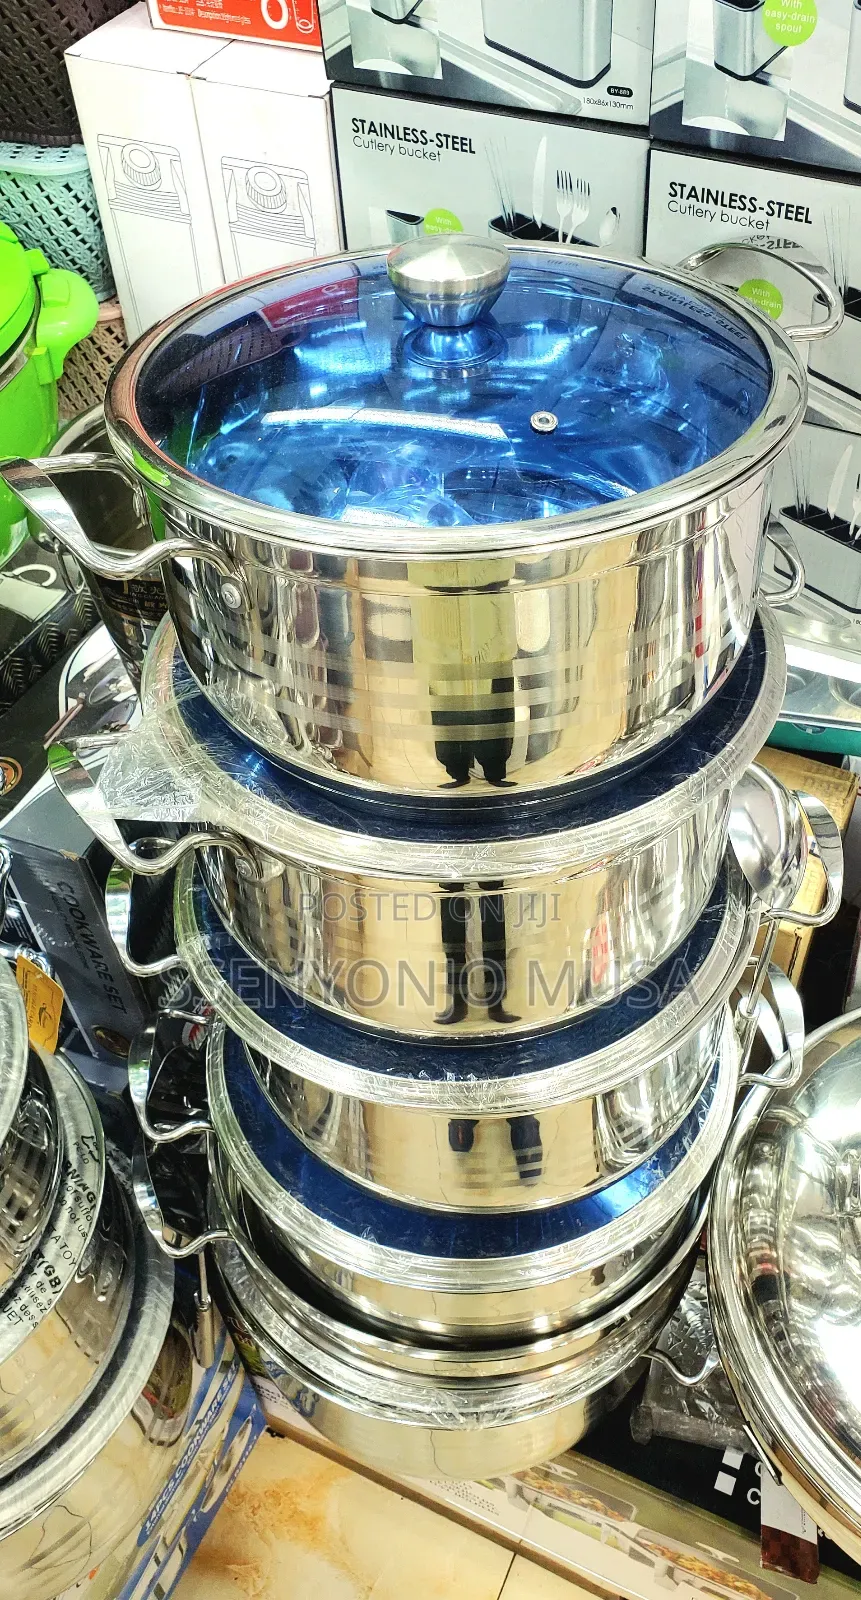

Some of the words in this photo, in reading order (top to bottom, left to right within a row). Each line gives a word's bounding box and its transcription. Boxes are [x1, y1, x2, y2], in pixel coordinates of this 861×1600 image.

[765, 9, 815, 23] easy-drain
[775, 22, 802, 33] spout
[351, 117, 476, 155] STAINLESS-STEEL
[352, 135, 396, 156] Cutlery
[398, 143, 442, 162] bucket
[667, 200, 717, 222] Cutlery
[720, 210, 770, 231] bucket
[668, 181, 813, 225] STAINLESS-STEEL
[751, 286, 771, 298] With
[56, 880, 114, 983] COOKWARE
[102, 982, 128, 1015] SET
[66, 1205, 81, 1224] not
[75, 1195, 93, 1226] suffo
[59, 1242, 77, 1267] TOY
[23, 1285, 48, 1314] tilisez
[36, 1280, 47, 1294] de
[19, 1303, 36, 1321] des
